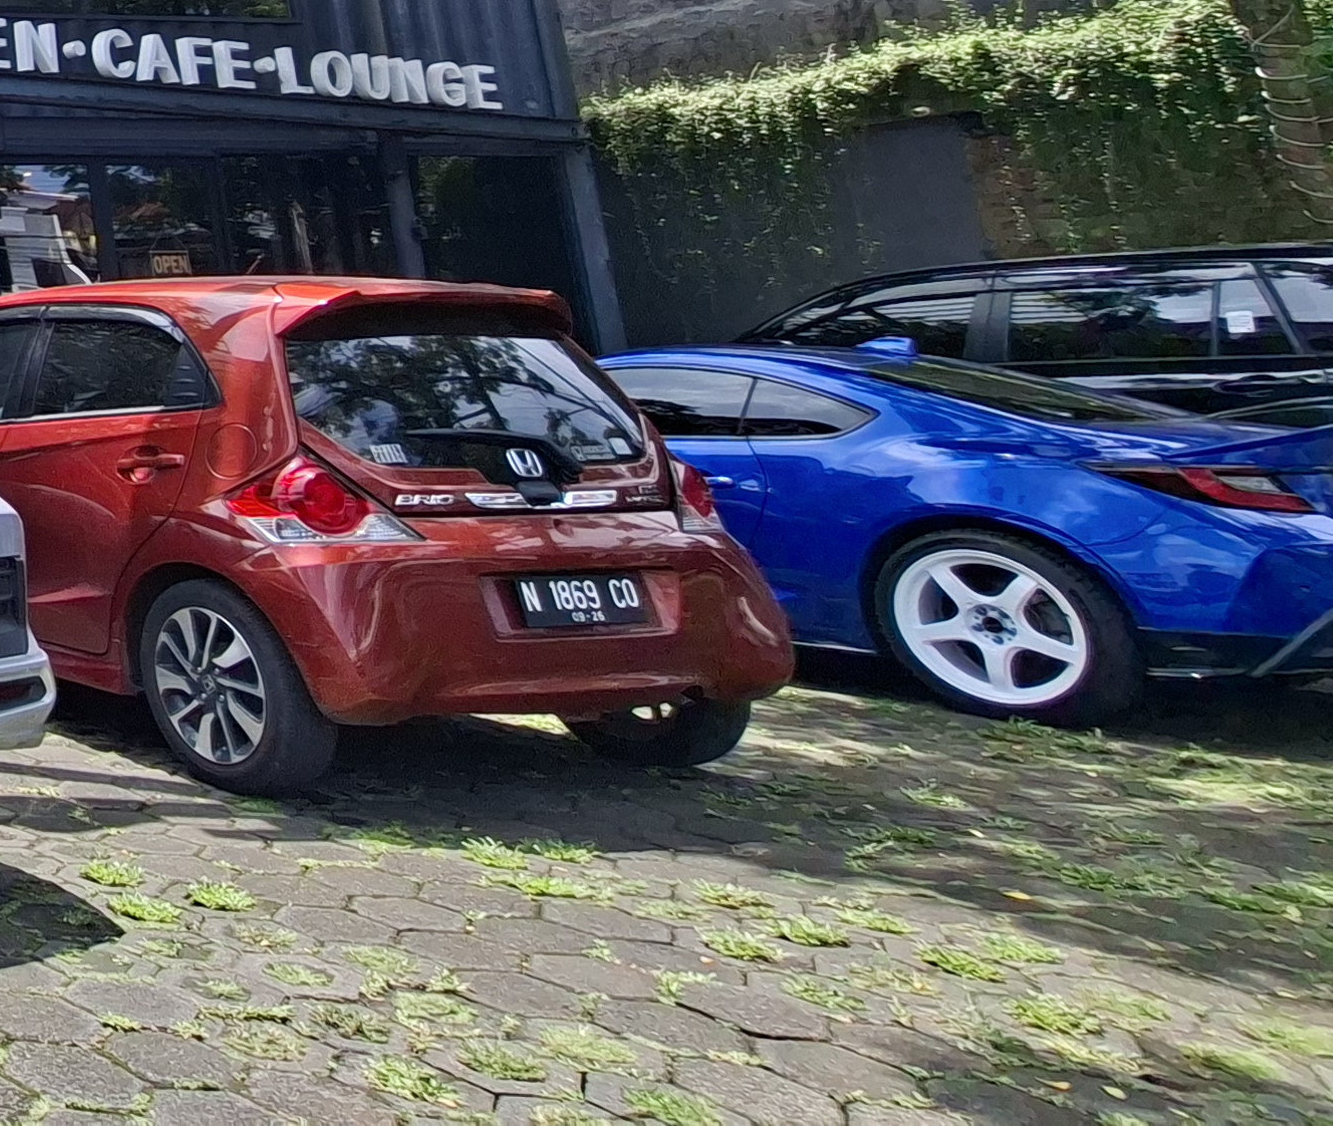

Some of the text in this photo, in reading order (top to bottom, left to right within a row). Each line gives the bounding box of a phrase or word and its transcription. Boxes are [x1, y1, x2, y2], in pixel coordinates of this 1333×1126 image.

[91, 29, 256, 89] CAFE
[274, 46, 503, 110] LOUNGE
[153, 255, 192, 274] OPEN
[394, 494, 455, 506] BRIO
[520, 581, 542, 612] N
[549, 580, 601, 610] 1869
